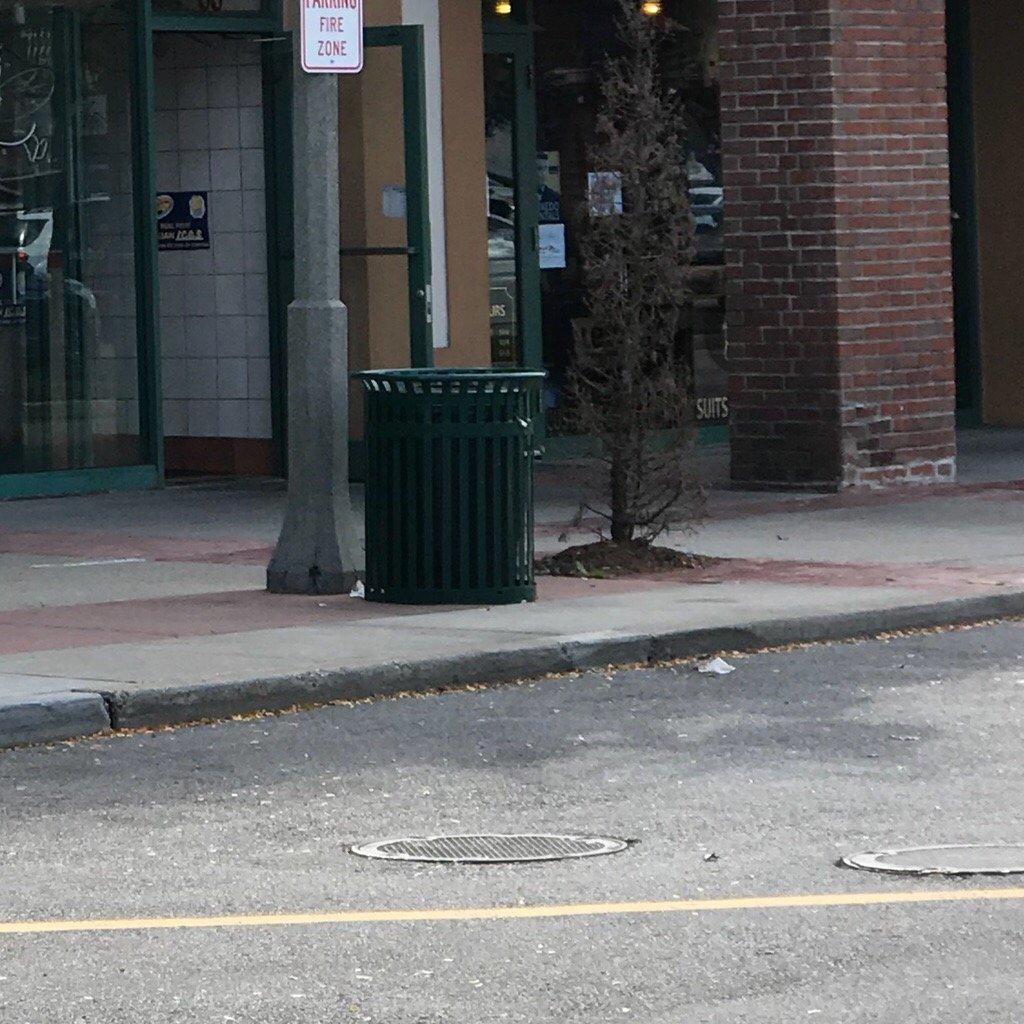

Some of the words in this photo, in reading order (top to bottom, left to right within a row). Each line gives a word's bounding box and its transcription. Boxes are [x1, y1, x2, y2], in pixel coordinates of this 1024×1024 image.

[319, 16, 344, 33] FIRE
[317, 40, 347, 57] ZONE
[696, 396, 729, 420] SUITS
